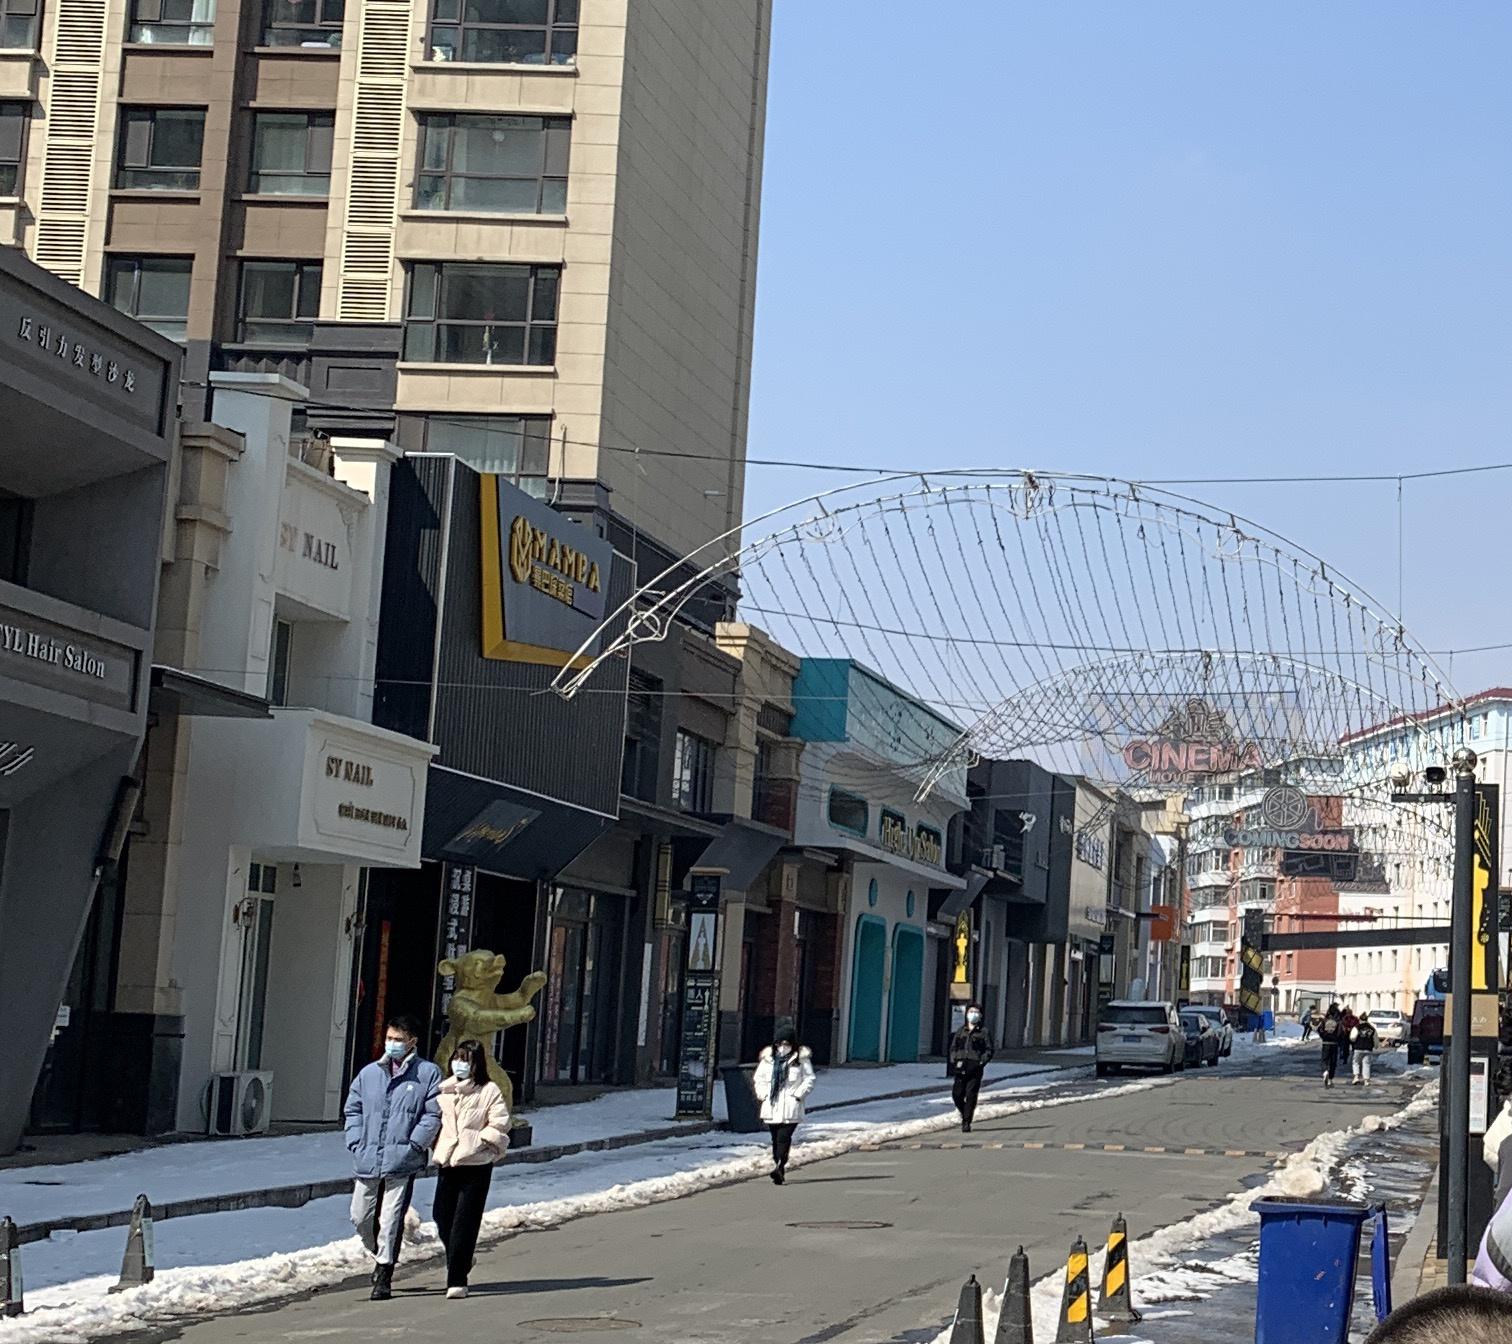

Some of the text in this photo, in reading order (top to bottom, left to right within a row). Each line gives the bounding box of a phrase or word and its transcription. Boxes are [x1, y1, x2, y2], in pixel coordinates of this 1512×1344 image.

[19, 316, 135, 393] 反引力发型沙龙
[302, 531, 339, 571] NAIL
[531, 527, 601, 593] MAMBA
[0, 623, 105, 678] YL Hair Salon
[344, 760, 374, 786] NAIL
[1122, 739, 1263, 773] CINEMA
[1149, 770, 1239, 785] MOVIE TIME
[1223, 827, 1350, 851] COMING SOON
